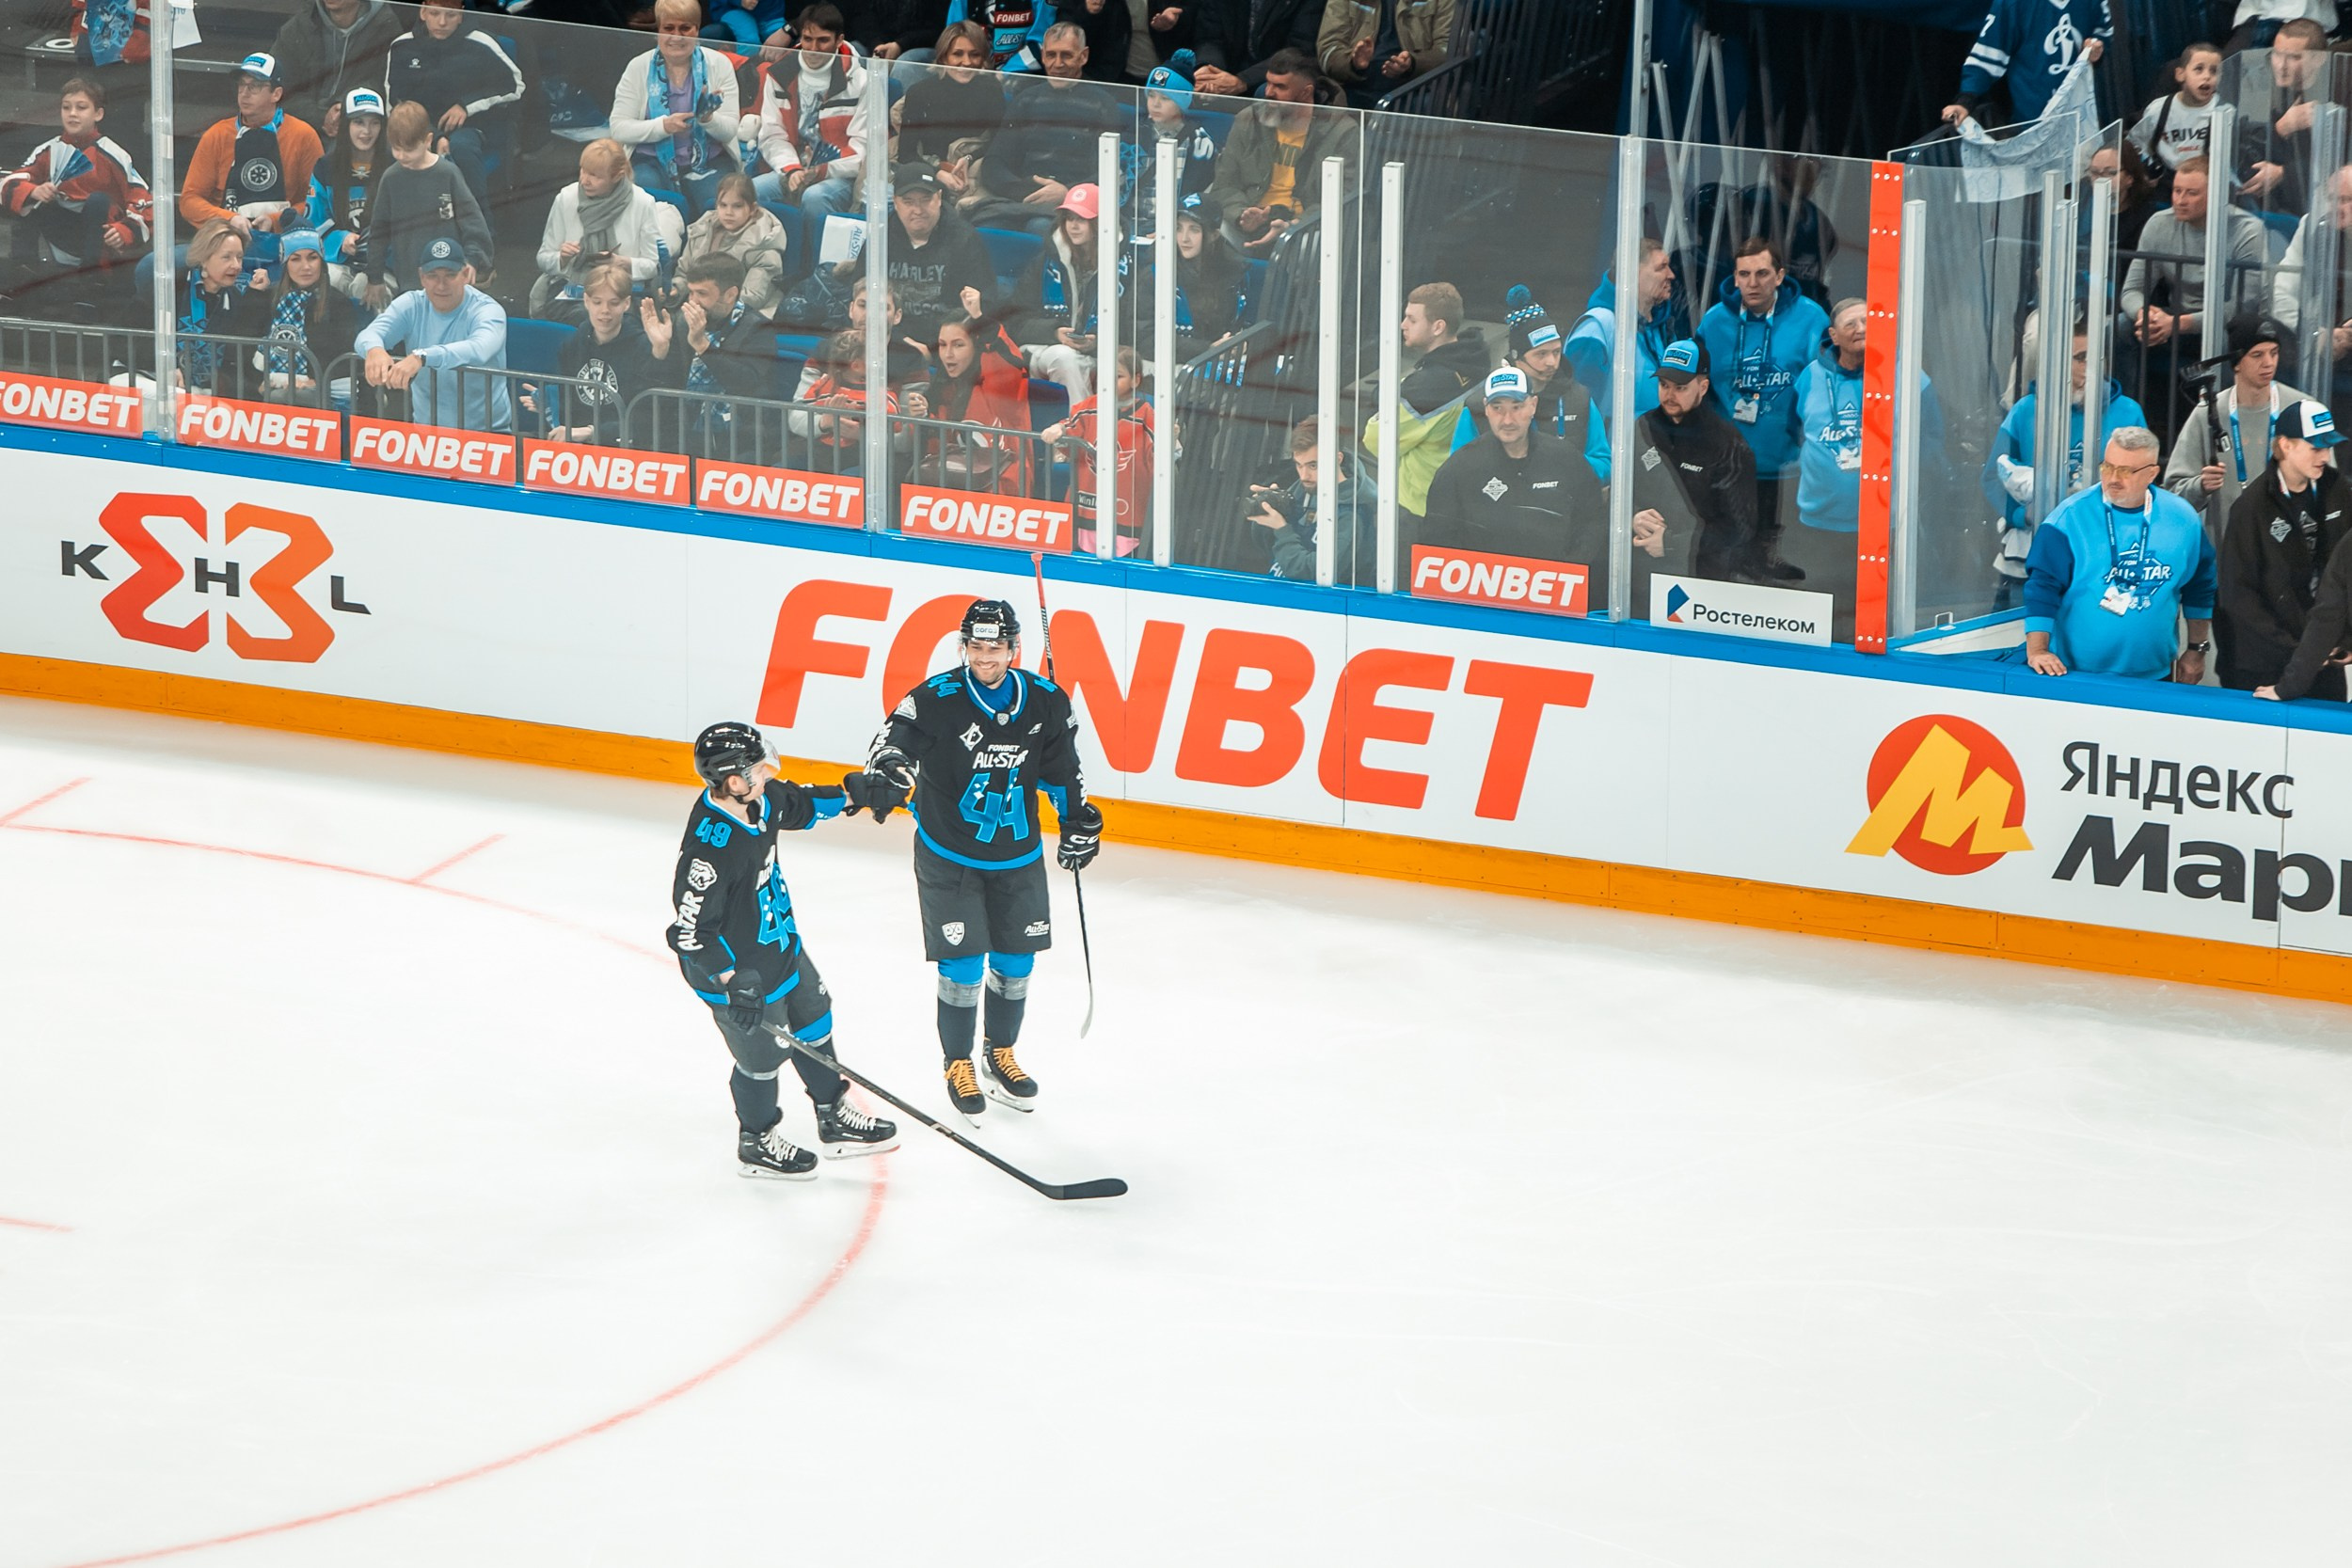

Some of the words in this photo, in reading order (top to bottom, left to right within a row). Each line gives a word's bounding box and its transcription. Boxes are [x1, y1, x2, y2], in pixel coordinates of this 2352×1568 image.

[996, 11, 1031, 23] FONBET
[0, 381, 139, 428] ONBET
[180, 404, 338, 451] FONBET
[353, 427, 513, 476] FONBET
[526, 449, 687, 496] FONBET
[1680, 462, 1704, 472] FONBET
[699, 469, 861, 518] FONBET
[1533, 481, 1559, 490] FONBET
[903, 495, 1070, 545] FONBET
[1414, 556, 1585, 607] FONBET
[1693, 603, 1815, 634] Ростелеком
[755, 579, 1595, 822] FONBET
[928, 673, 961, 698] 44
[987, 744, 1021, 752] FONBET
[2060, 740, 2295, 819] Яндекс
[959, 768, 1029, 844] 44
[694, 816, 733, 847] 49
[2051, 814, 2352, 923] Мар
